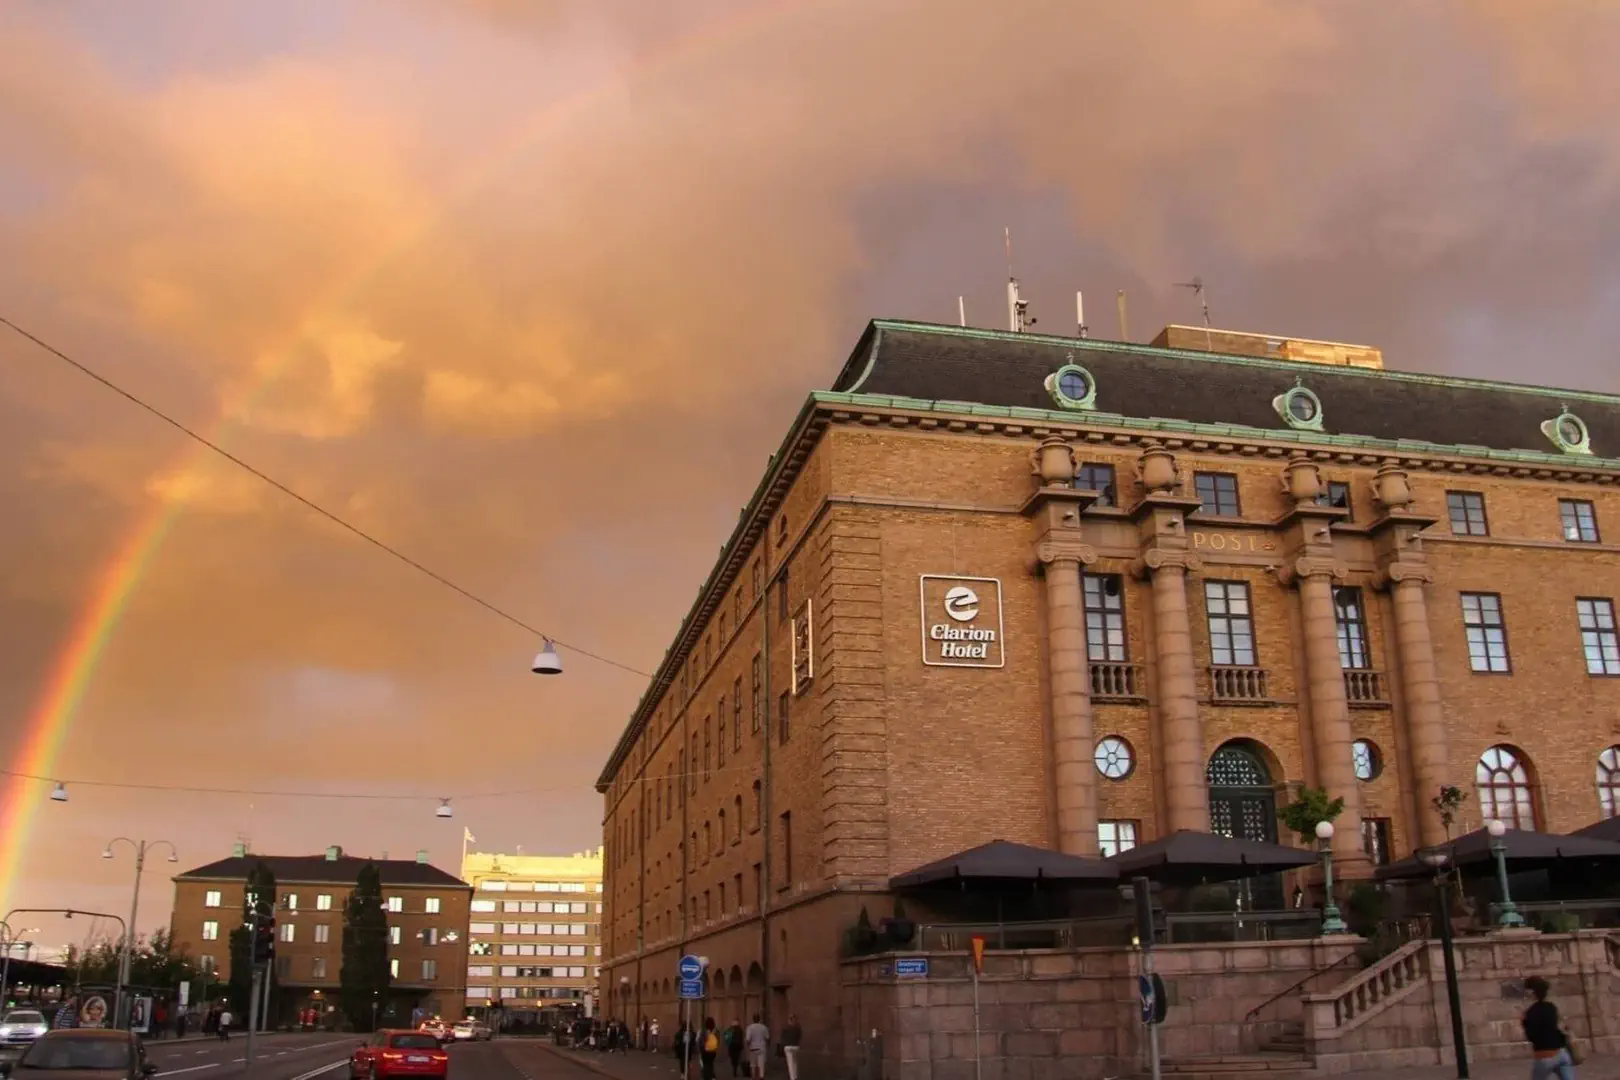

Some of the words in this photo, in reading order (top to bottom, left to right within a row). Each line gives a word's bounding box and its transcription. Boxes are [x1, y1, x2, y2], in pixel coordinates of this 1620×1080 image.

[1193, 532, 1257, 551] POST
[930, 624, 996, 641] Clarion
[941, 642, 988, 658] Hotel
